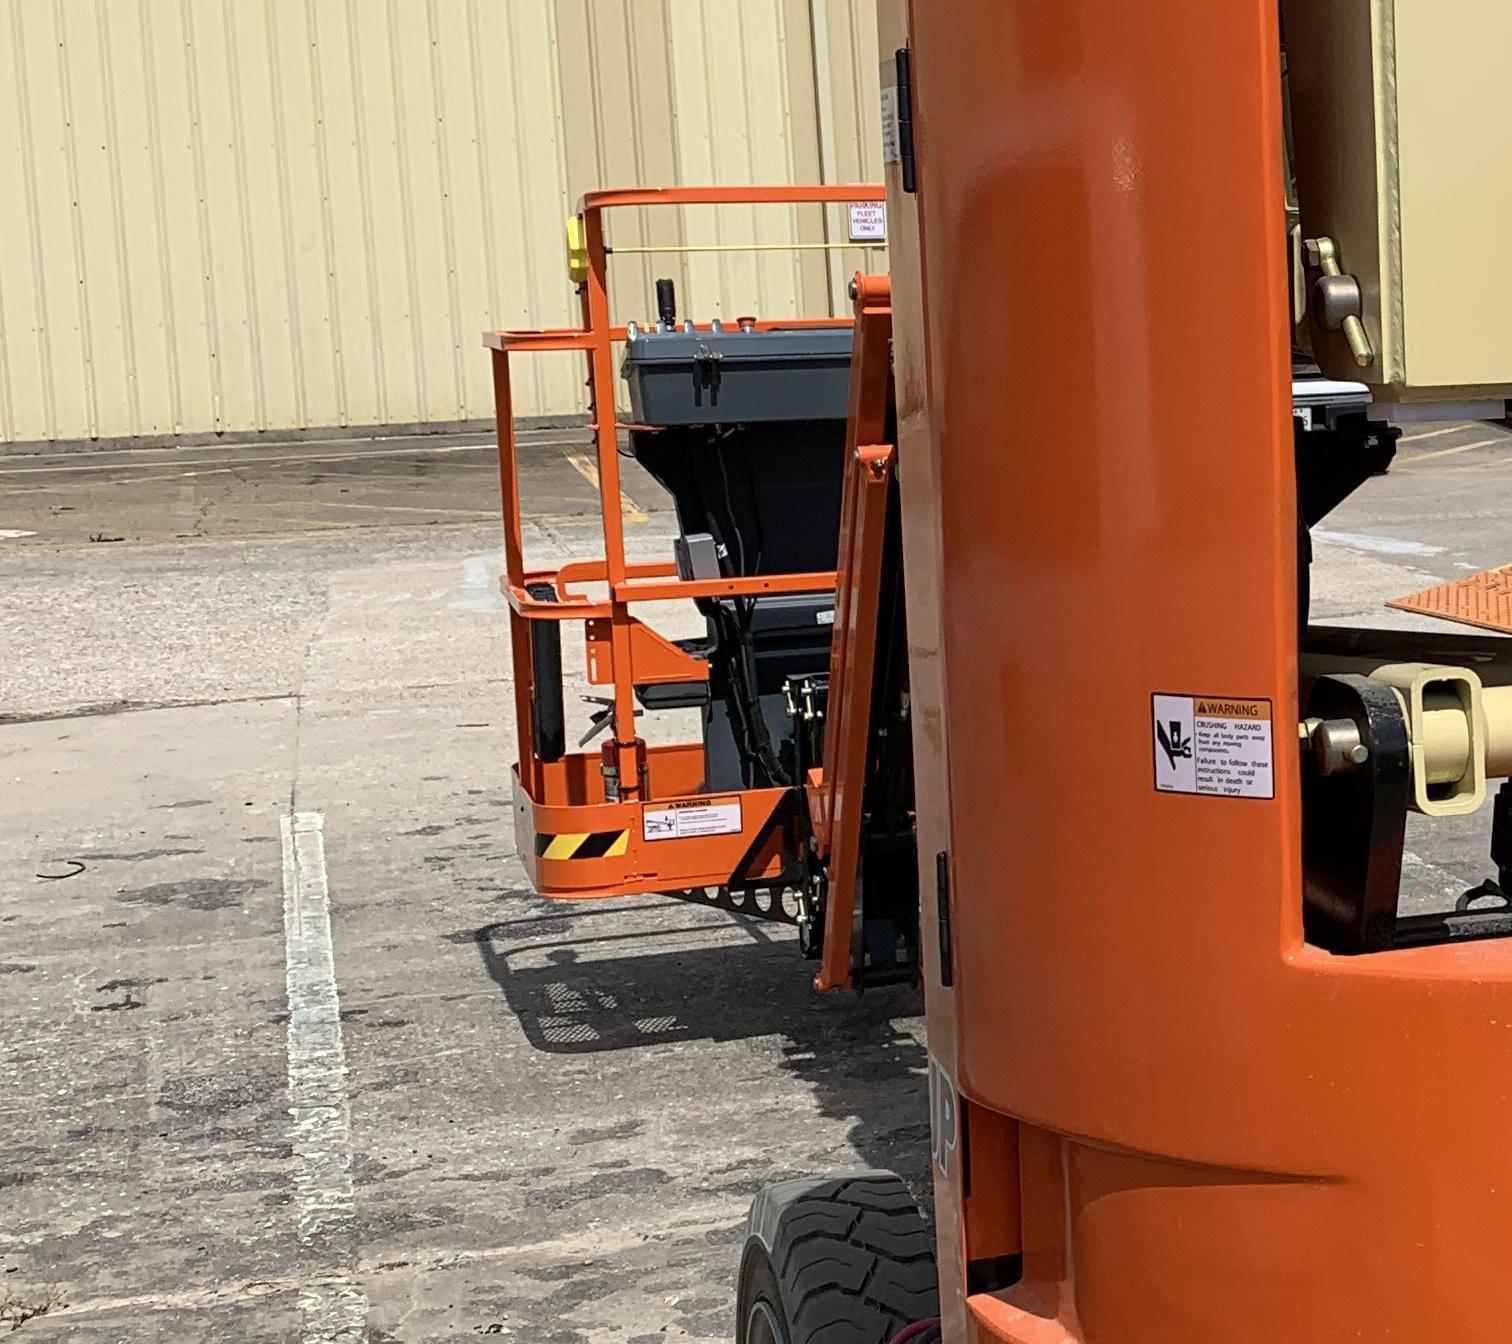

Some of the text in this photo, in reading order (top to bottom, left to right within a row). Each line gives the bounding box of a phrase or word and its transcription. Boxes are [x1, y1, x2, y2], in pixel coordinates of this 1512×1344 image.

[1207, 703, 1258, 716] WARNING
[1196, 721, 1262, 731] CRUSHING HAZARD
[1197, 757, 1216, 765] Failure
[1229, 759, 1248, 767] follow
[1251, 760, 1268, 768] these
[675, 800, 711, 809] WARNING
